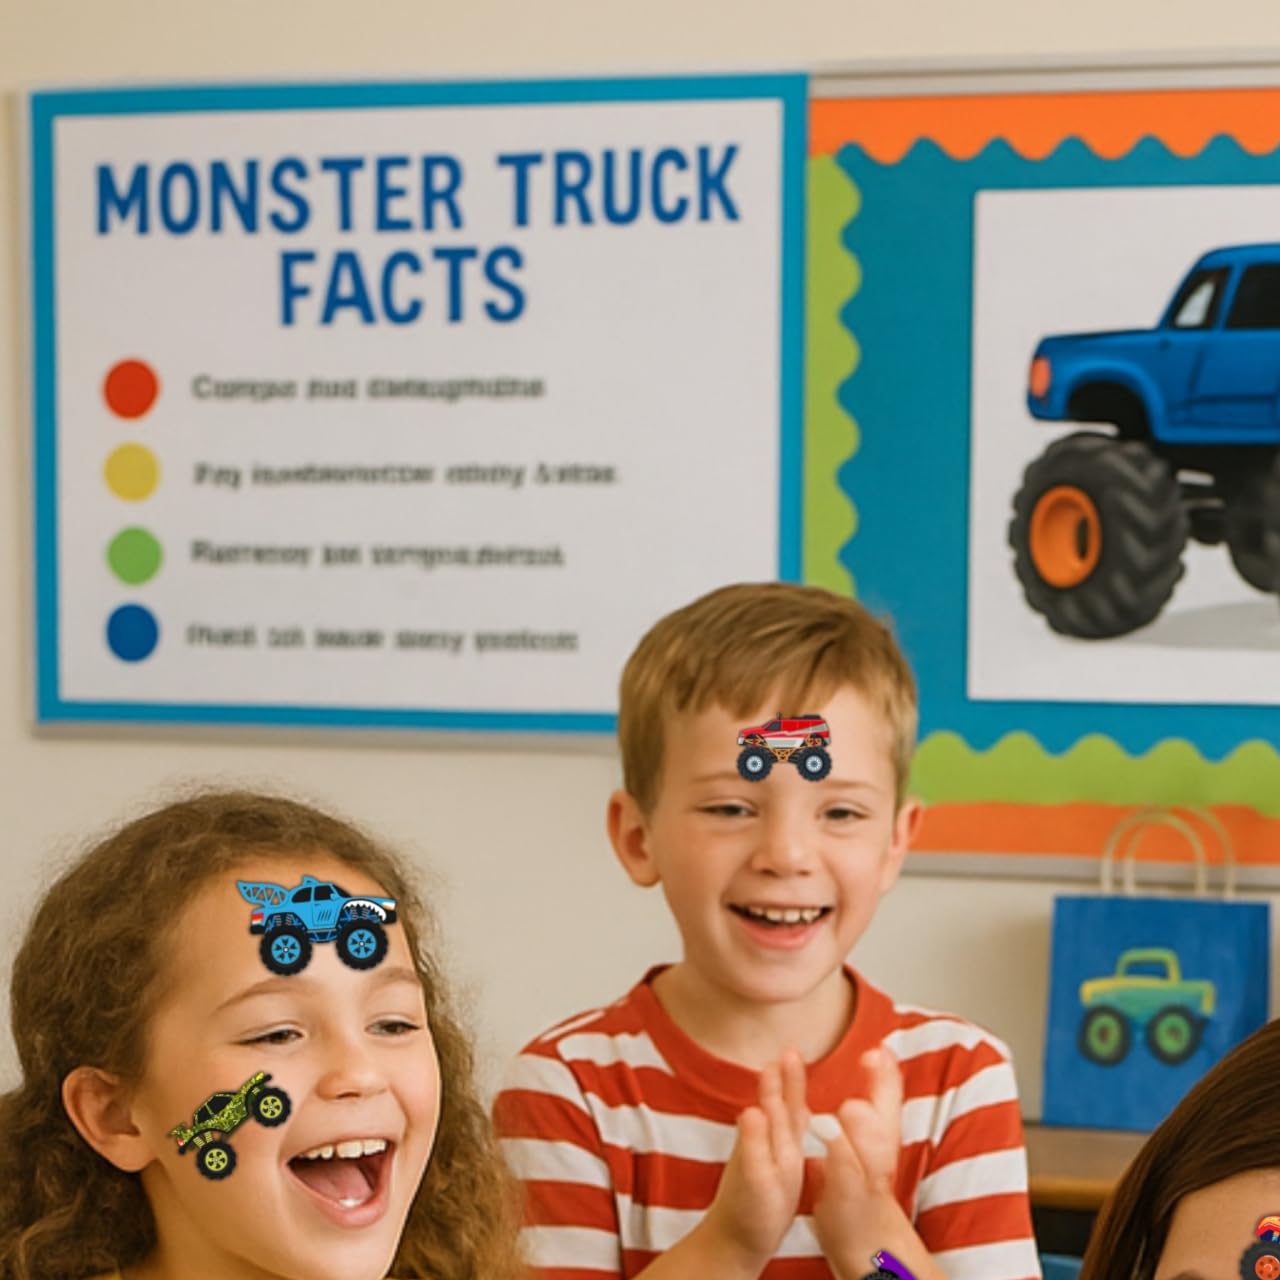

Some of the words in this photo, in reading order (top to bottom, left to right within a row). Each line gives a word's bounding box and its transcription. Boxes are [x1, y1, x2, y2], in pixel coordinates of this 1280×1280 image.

[96, 153, 464, 236] MONSTER
[497, 144, 740, 228] TRUCK
[279, 246, 528, 326] FACTS
